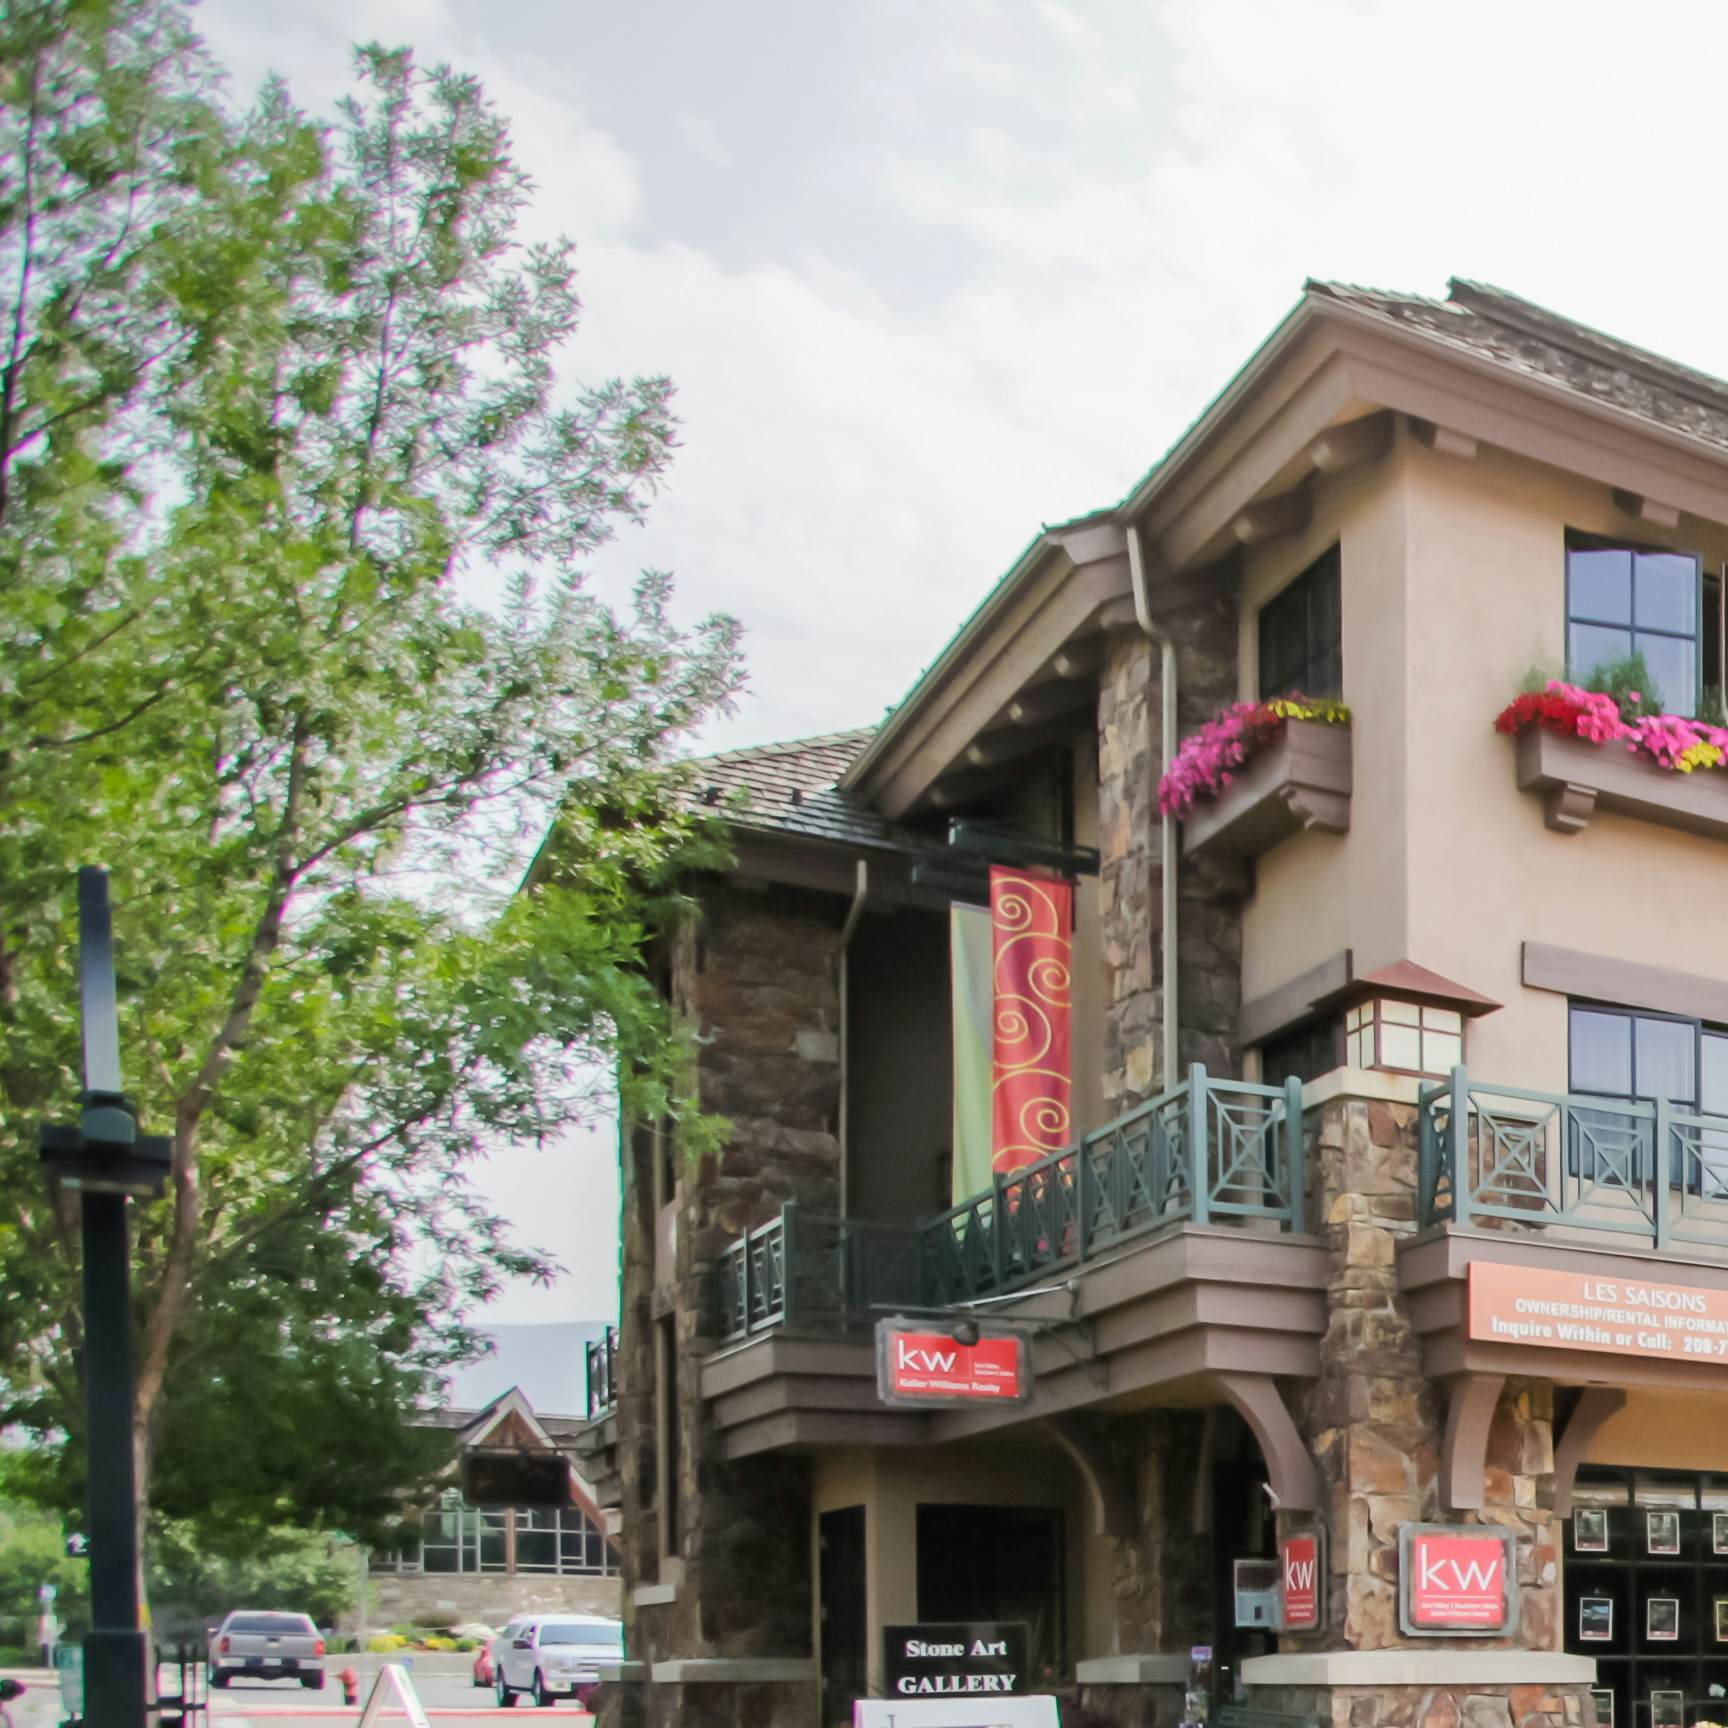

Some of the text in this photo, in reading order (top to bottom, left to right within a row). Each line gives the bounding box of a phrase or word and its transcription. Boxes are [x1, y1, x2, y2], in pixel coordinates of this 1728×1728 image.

[1515, 1298, 1660, 1328] OWNERSHIP/RENTAL
[1584, 1282, 1708, 1313] LES SAISONS
[1492, 1317, 1552, 1339] Inquire
[1557, 1323, 1611, 1345] Within
[1615, 1333, 1632, 1346] or
[1637, 1332, 1672, 1350] Call:
[898, 1339, 957, 1373] kw
[1286, 1547, 1314, 1592] kw
[1420, 1543, 1498, 1592] kw
[906, 1639, 1008, 1658] Stone Art
[898, 1674, 1017, 1694] GALLERY
